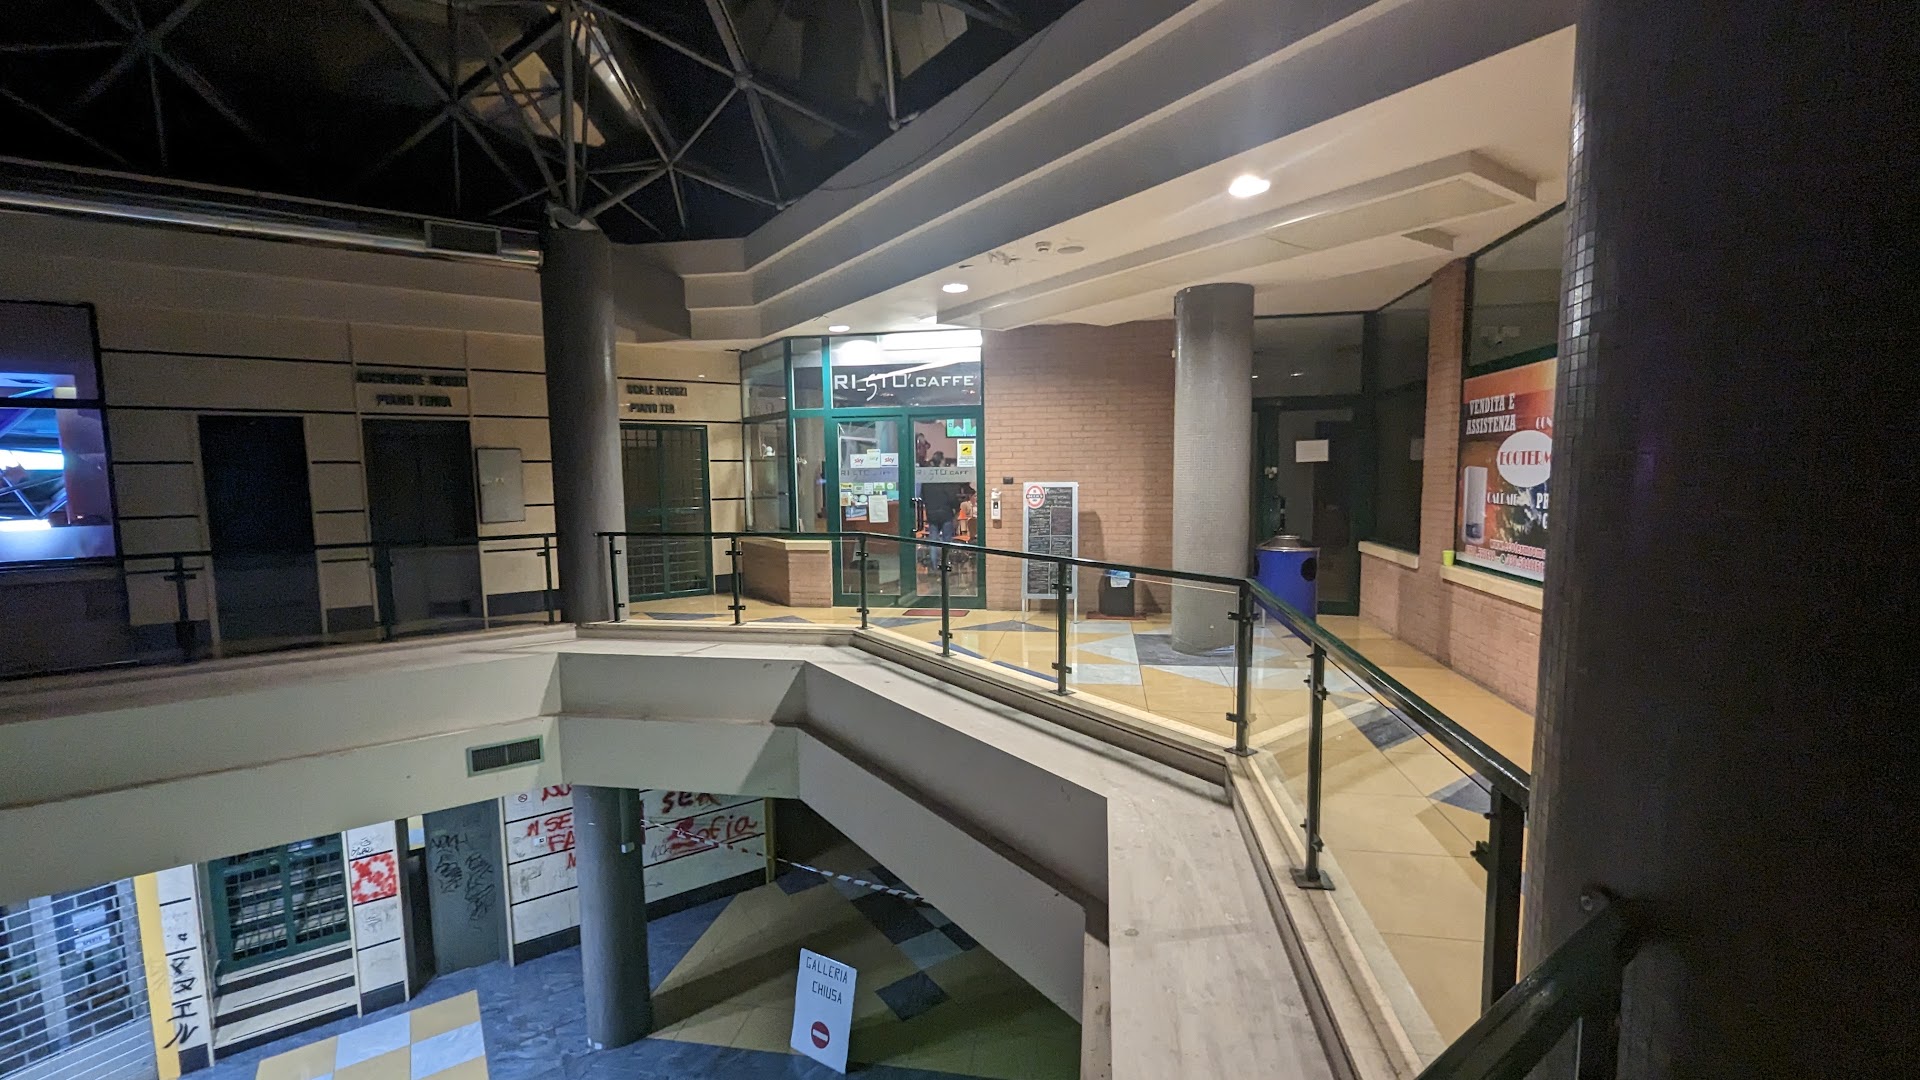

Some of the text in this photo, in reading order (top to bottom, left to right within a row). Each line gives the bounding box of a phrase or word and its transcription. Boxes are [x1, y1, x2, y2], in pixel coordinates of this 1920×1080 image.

[1469, 392, 1516, 416] VENDITA E
[1465, 414, 1517, 435] ASSISTENZA
[806, 956, 848, 984] GALLERIA
[812, 980, 842, 1004] CHIUSA
